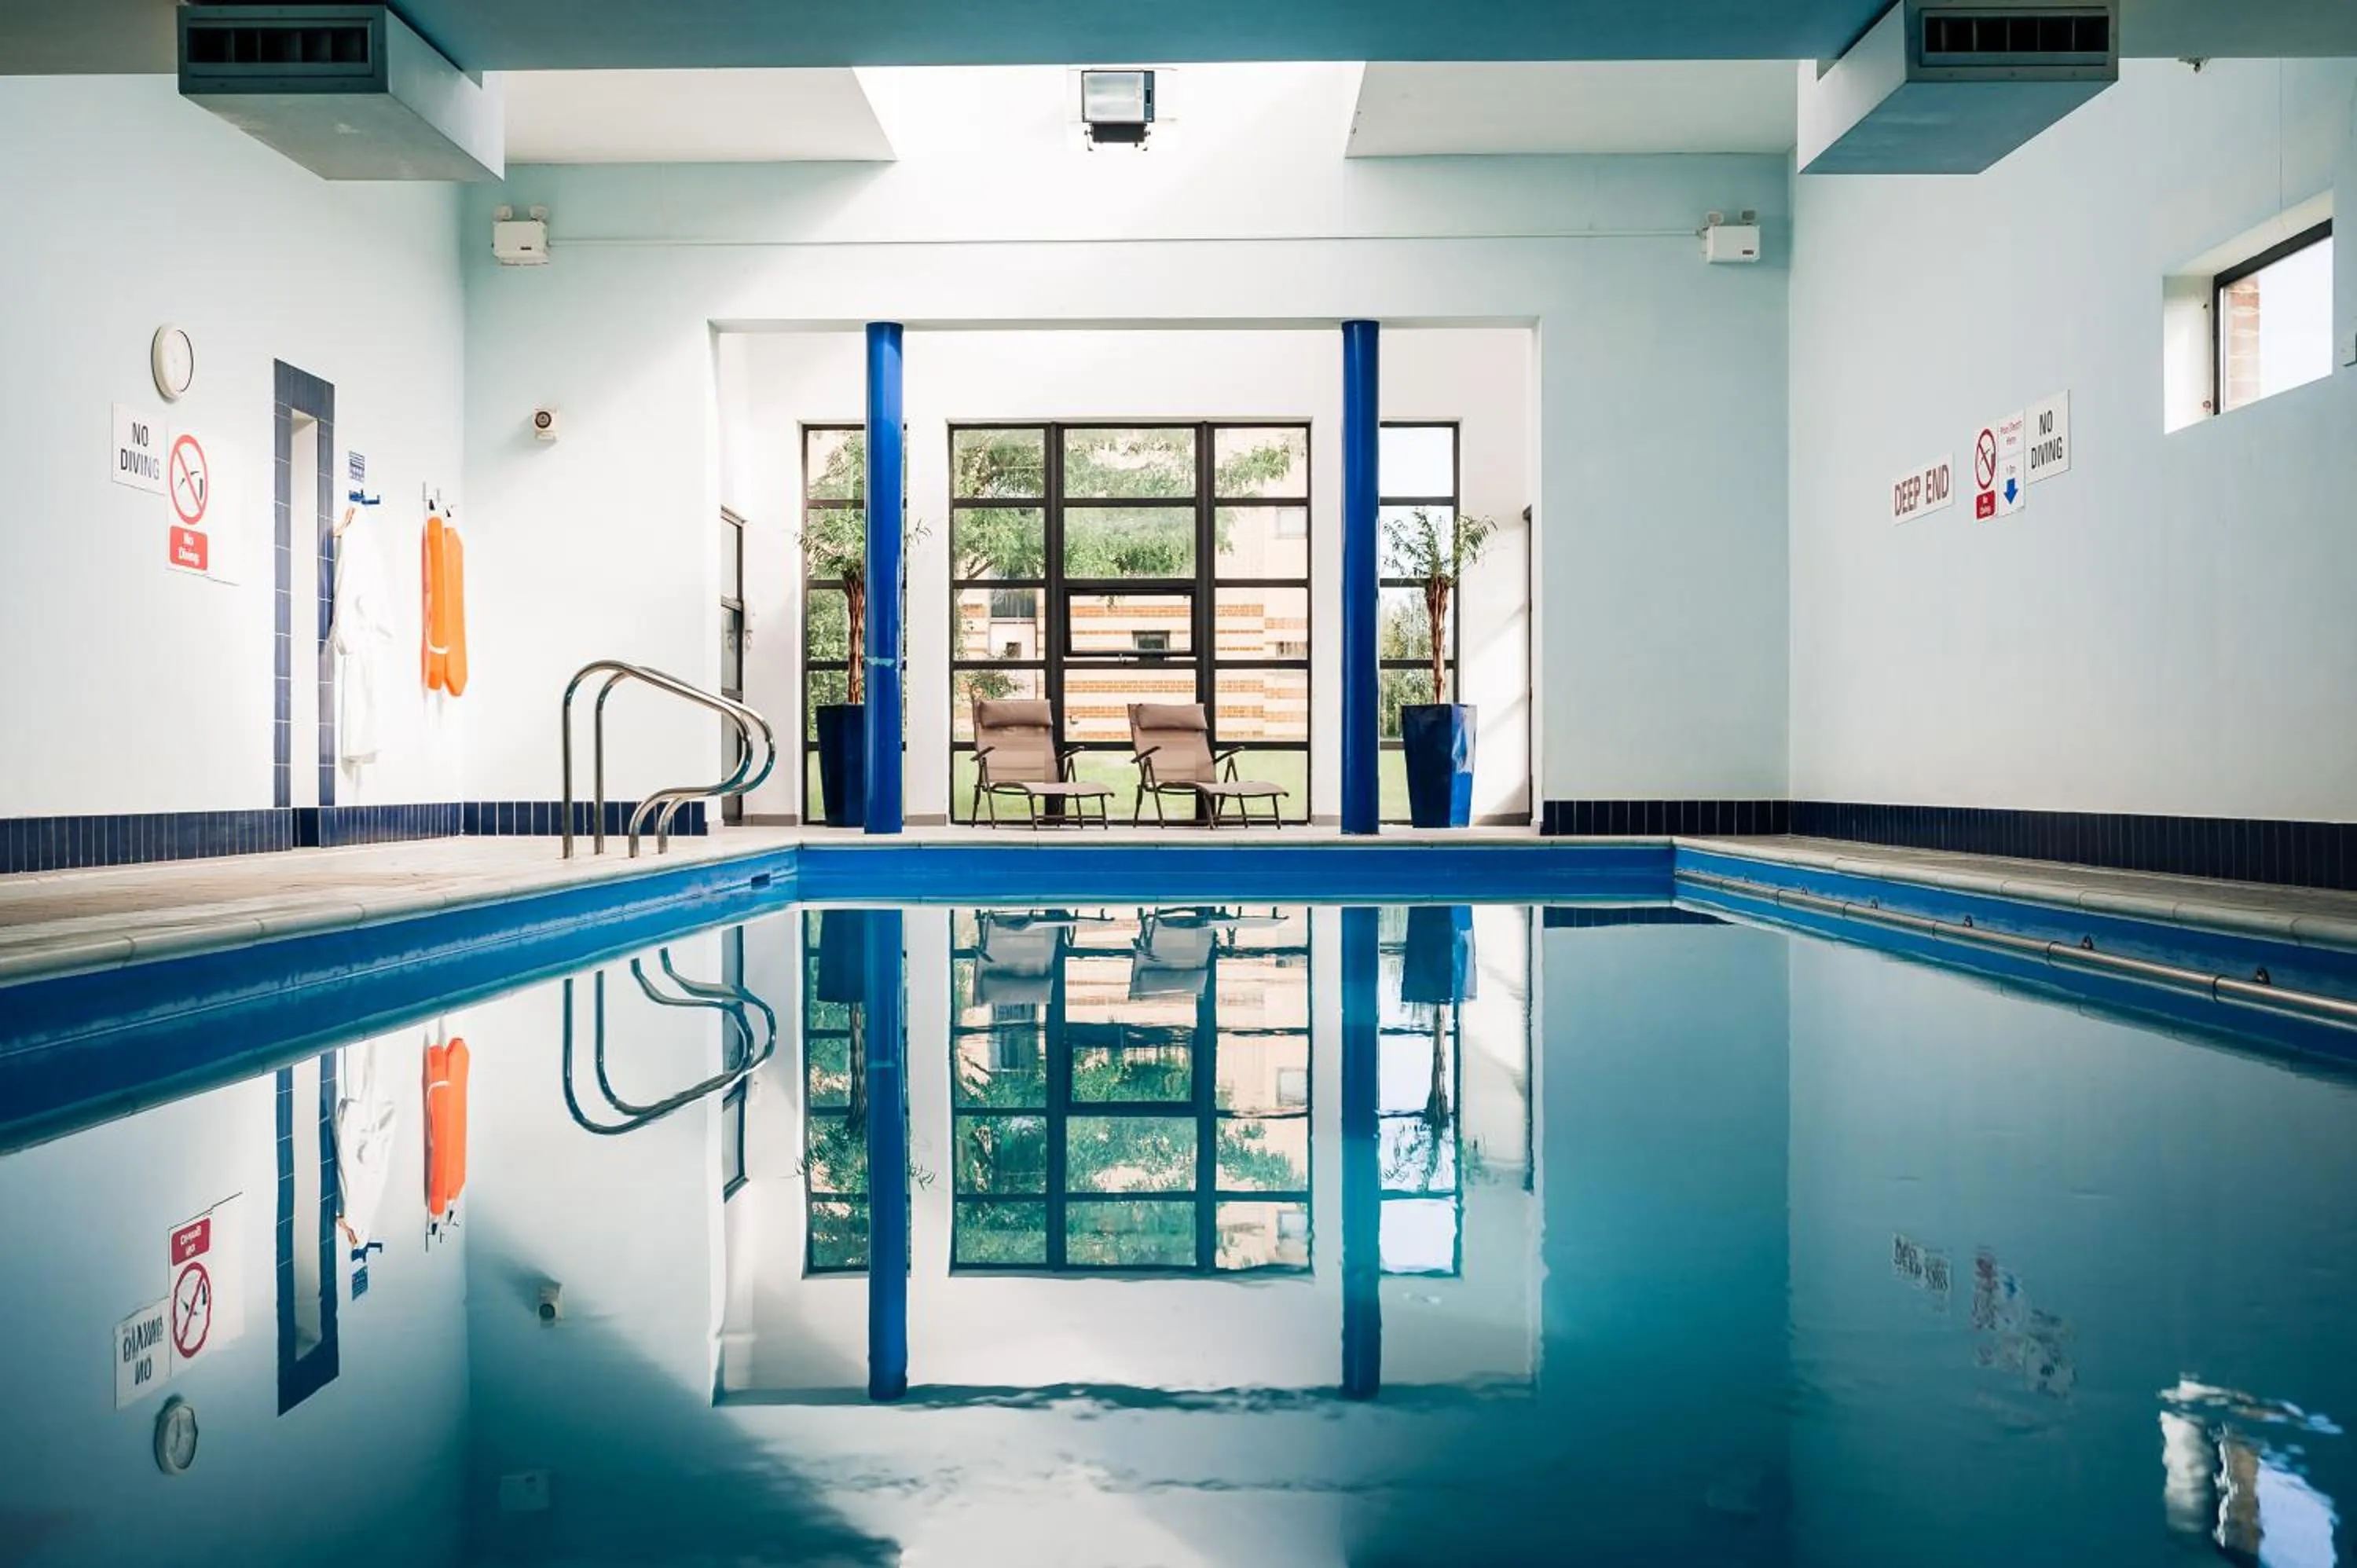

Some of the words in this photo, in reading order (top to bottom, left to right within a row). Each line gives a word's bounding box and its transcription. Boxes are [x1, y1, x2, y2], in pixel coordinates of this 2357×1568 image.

[132, 422, 149, 447] NO
[2039, 410, 2053, 436] NO
[120, 448, 159, 481] DIVING
[2031, 436, 2062, 470] DIVING
[1893, 475, 1921, 517] DEEP
[1926, 463, 1949, 504] END
